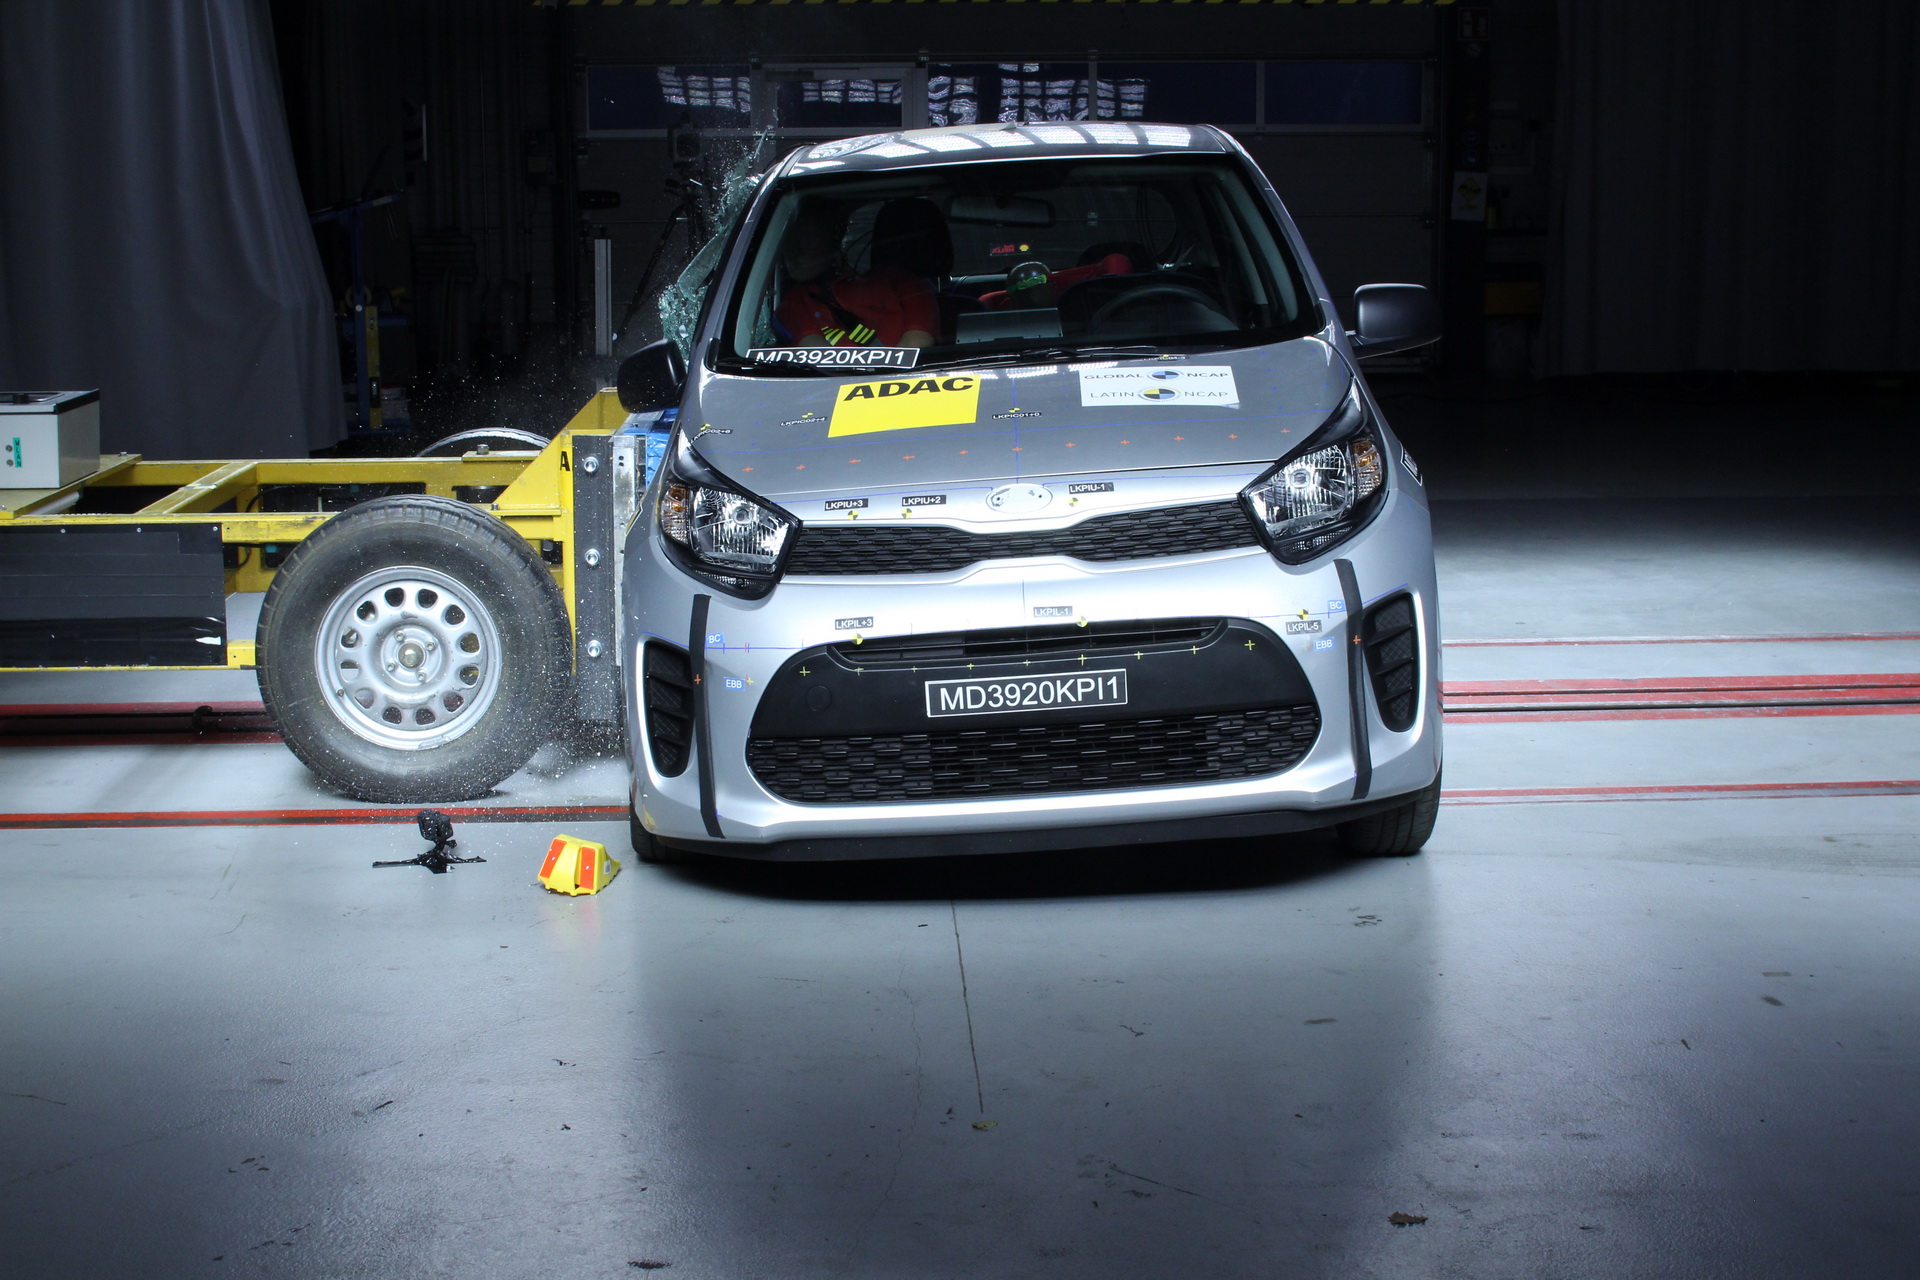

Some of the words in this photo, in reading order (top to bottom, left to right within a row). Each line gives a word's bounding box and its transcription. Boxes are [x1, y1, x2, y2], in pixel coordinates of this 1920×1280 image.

[755, 350, 905, 365] MD3920KPI1
[843, 377, 974, 402] ADAC
[560, 451, 571, 471] A
[1069, 483, 1105, 493] LKPIU-1
[825, 500, 863, 510] LKPIU+3
[903, 496, 941, 506] LKPIU+2
[1329, 601, 1342, 610] BC
[1034, 607, 1069, 617] LKPIL-1
[835, 618, 872, 629] LKPIL+3
[1287, 621, 1319, 632] LKPIL-5
[708, 634, 721, 644] BC
[1315, 639, 1333, 650] EBB
[725, 679, 743, 689] EBB
[940, 676, 1117, 711] MD3920KPI1
